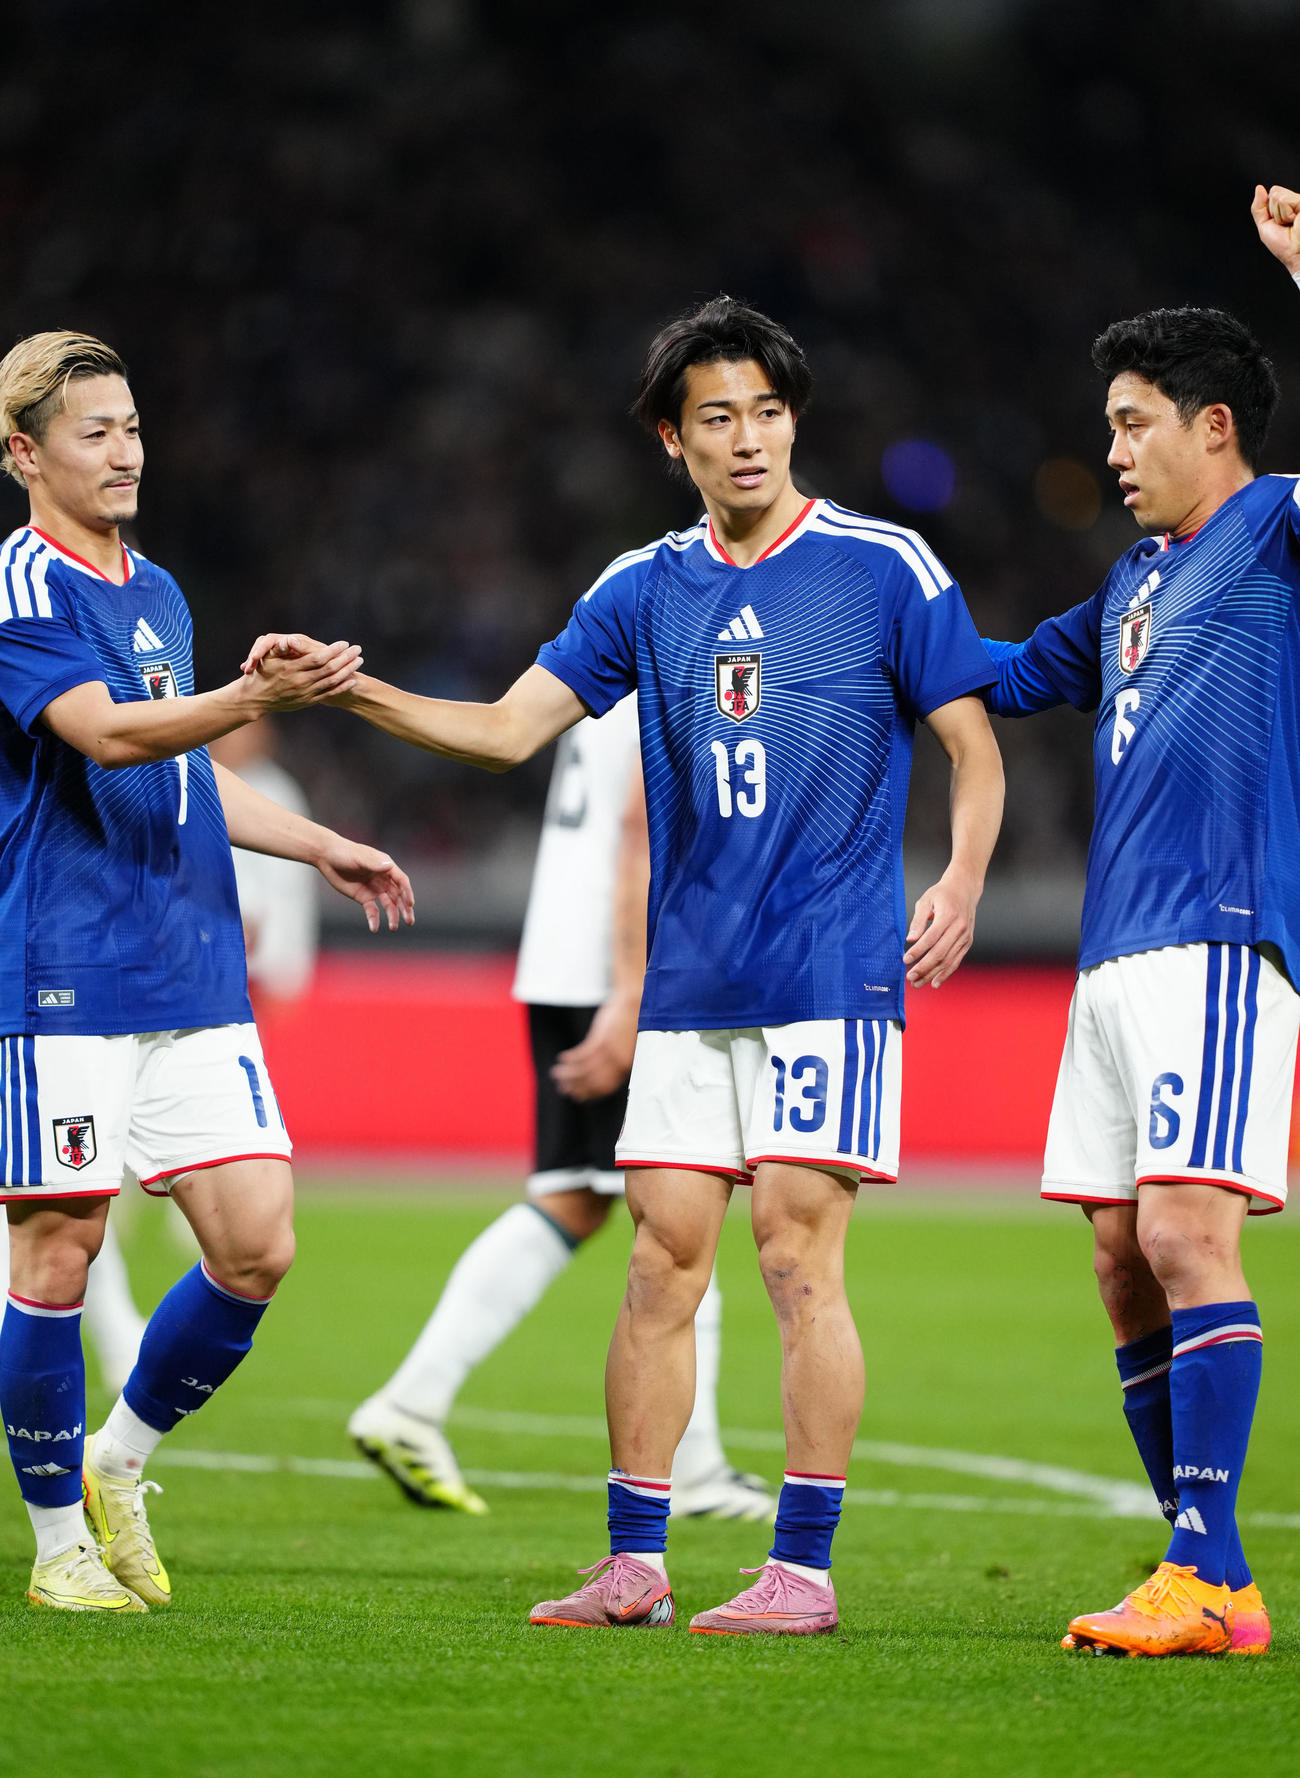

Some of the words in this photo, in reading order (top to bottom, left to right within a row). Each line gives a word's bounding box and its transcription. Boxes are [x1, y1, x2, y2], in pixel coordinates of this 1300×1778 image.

[1127, 609, 1144, 621] JAPAN
[143, 665, 163, 673] JAPAN
[729, 701, 750, 711] JFA
[1111, 688, 1140, 766] 6
[711, 739, 766, 818] 13
[770, 1055, 828, 1132] 13
[1149, 1072, 1184, 1149] 6
[68, 1153, 86, 1162] JFA
[7, 1422, 82, 1442] JAPAN
[1173, 1465, 1229, 1483] APAN
